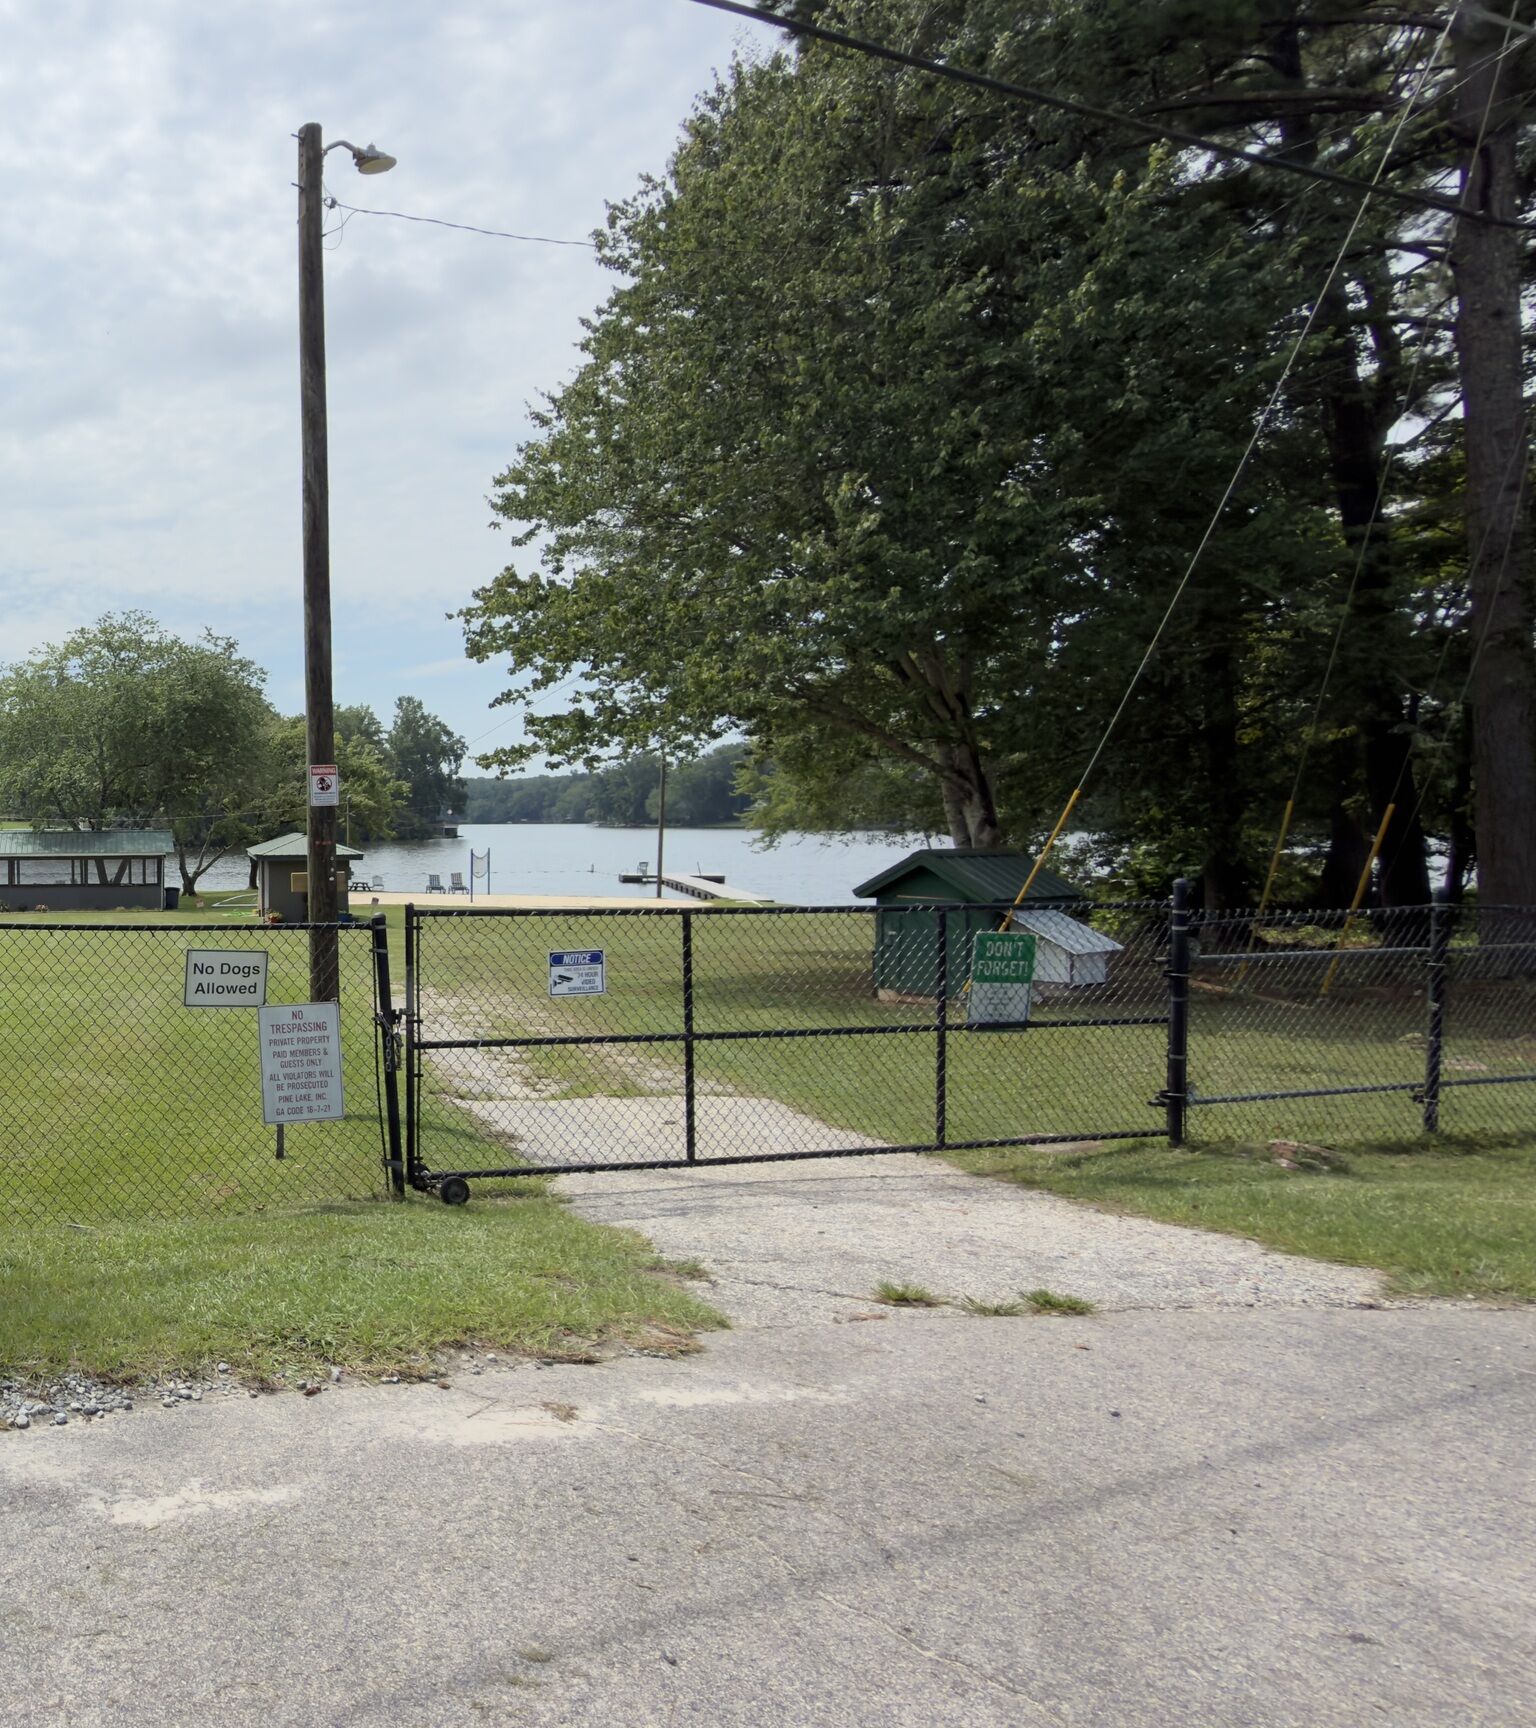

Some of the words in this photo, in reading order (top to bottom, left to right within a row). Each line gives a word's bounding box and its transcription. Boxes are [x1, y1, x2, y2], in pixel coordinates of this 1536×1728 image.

[986, 941, 1024, 957] DON'T
[563, 954, 591, 964] NOTICE
[194, 963, 214, 974] No
[221, 963, 260, 977] Dogs
[977, 961, 1028, 976] FORGET!
[195, 982, 257, 994] Allowed
[292, 1010, 303, 1020] NO
[270, 1021, 327, 1034] TRESPASSING
[269, 1038, 295, 1046] PRIVATE
[297, 1036, 329, 1045] PROPERTY
[290, 1048, 321, 1057] MEMBERS
[280, 1060, 304, 1068] GUESTS
[270, 1073, 280, 1081] ALL
[284, 1071, 316, 1080] VIOLATORS
[319, 1070, 334, 1078] WILL
[287, 1081, 328, 1090] PROSECUTED
[279, 1095, 293, 1103] PINE
[287, 1107, 303, 1115] CODE
[307, 1105, 330, 1113] 16-7-21
